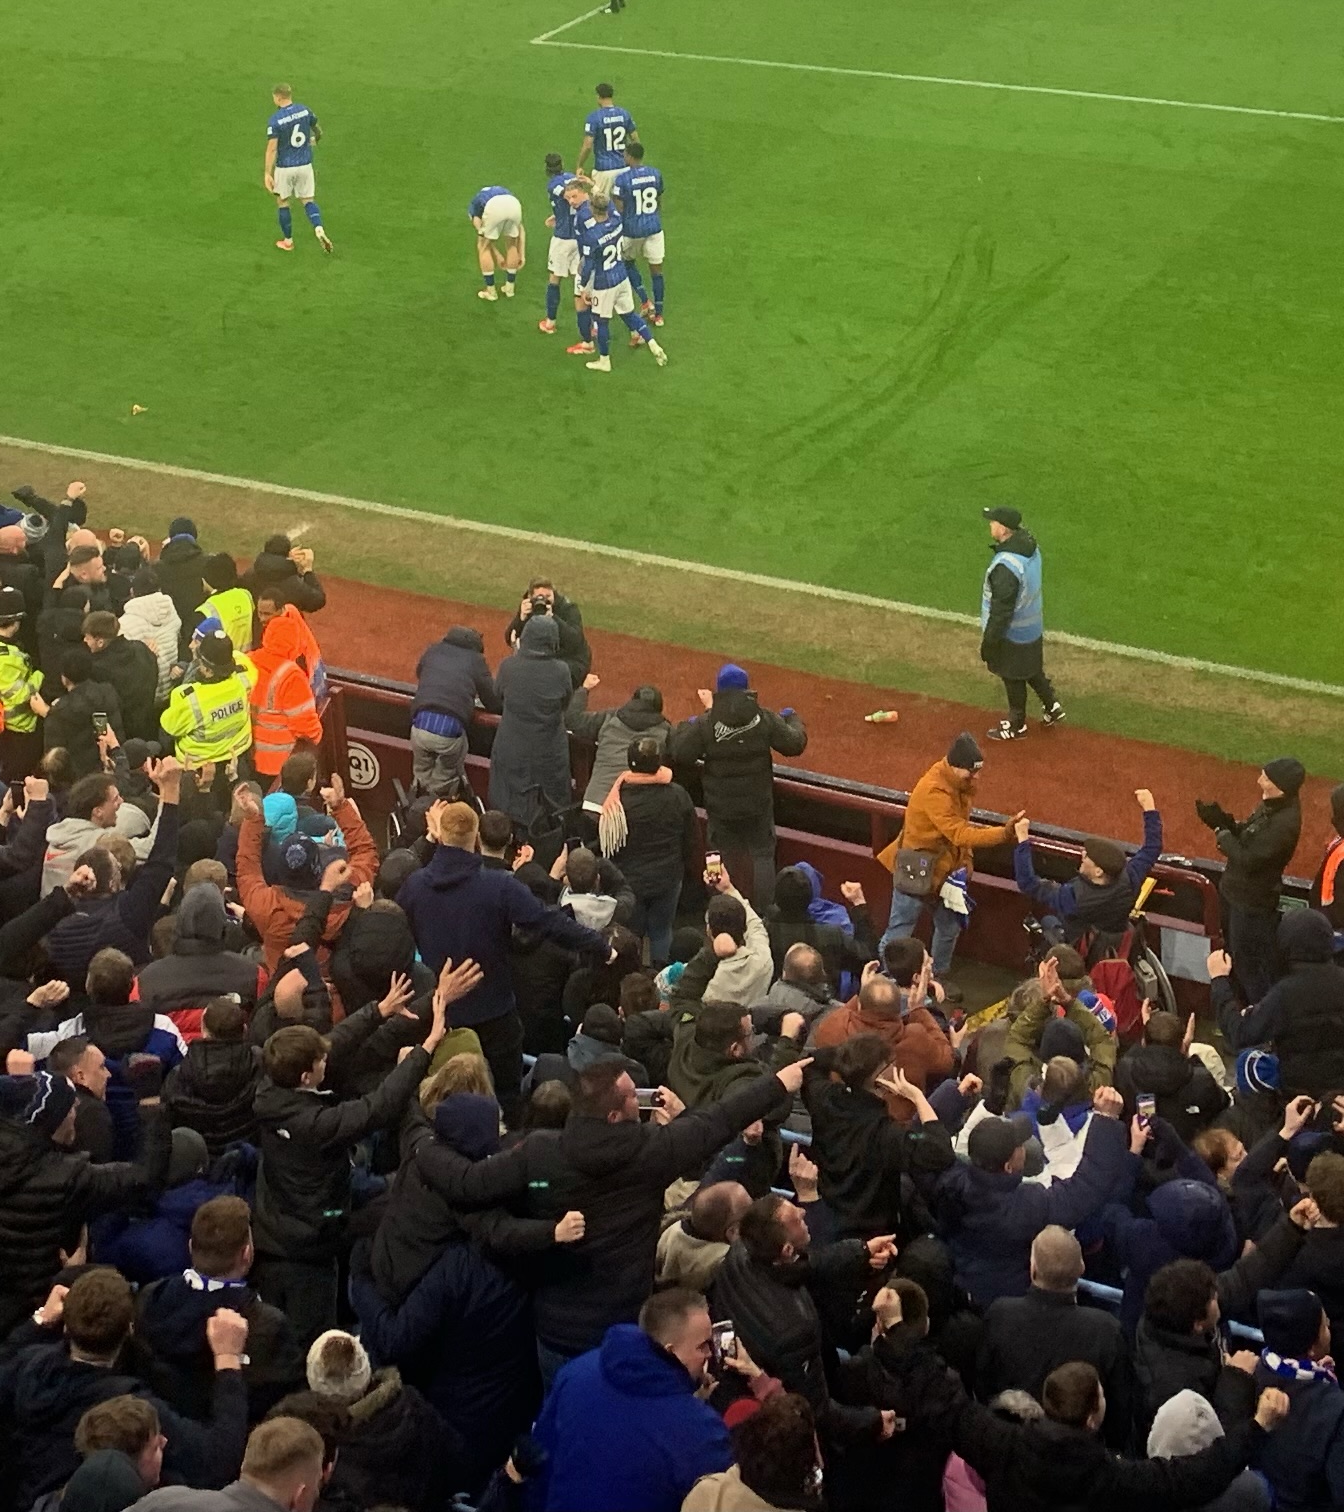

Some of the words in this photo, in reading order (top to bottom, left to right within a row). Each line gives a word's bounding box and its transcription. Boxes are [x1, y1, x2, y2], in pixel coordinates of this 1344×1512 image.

[290, 123, 307, 148] 6
[603, 126, 627, 152] 12
[633, 187, 658, 215] 18
[211, 700, 244, 722] POLICE
[349, 755, 369, 772] Q1
